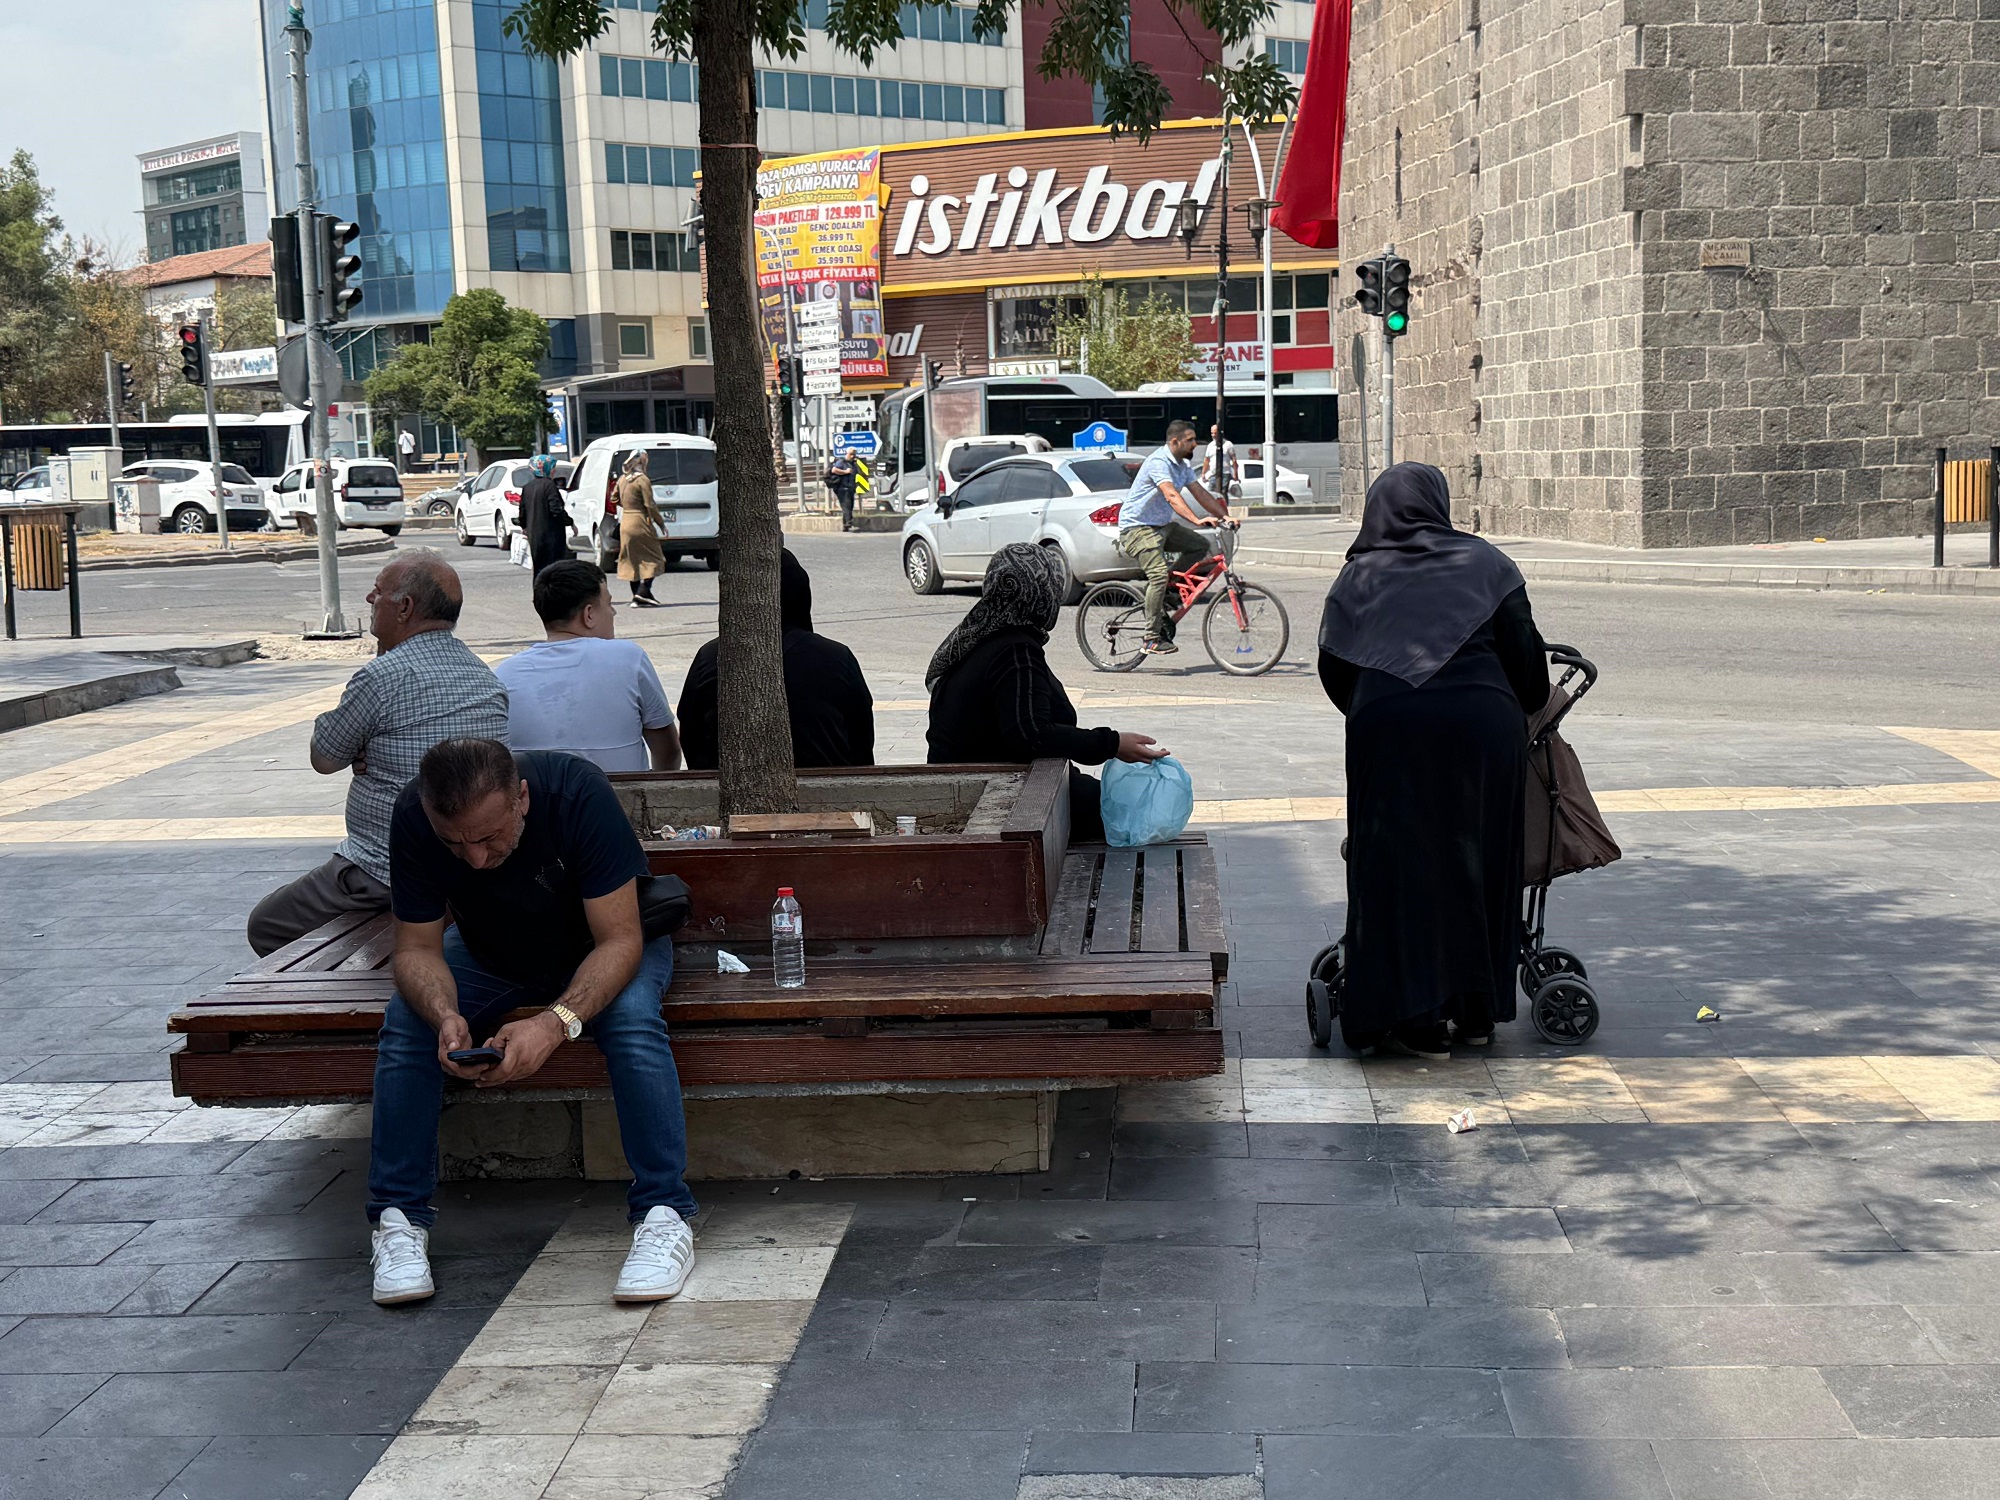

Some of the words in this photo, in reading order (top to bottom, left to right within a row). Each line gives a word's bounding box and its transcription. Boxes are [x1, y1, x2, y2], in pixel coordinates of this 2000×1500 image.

[819, 159, 873, 174] VURACAK
[785, 174, 860, 194] KAMPANYA
[778, 206, 819, 223] PAKETLERİ
[825, 205, 862, 221] 129.999
[863, 204, 876, 219] TL
[893, 158, 1222, 256] istikbal
[831, 221, 865, 230] ODALARI
[846, 232, 855, 241] TL
[811, 245, 836, 254] YEMEK
[837, 244, 863, 252] ODASI
[846, 255, 855, 264] TL
[801, 269, 821, 281] ŞOK
[822, 266, 876, 278] FİYATLAR
[1001, 326, 1050, 344] SAİM
